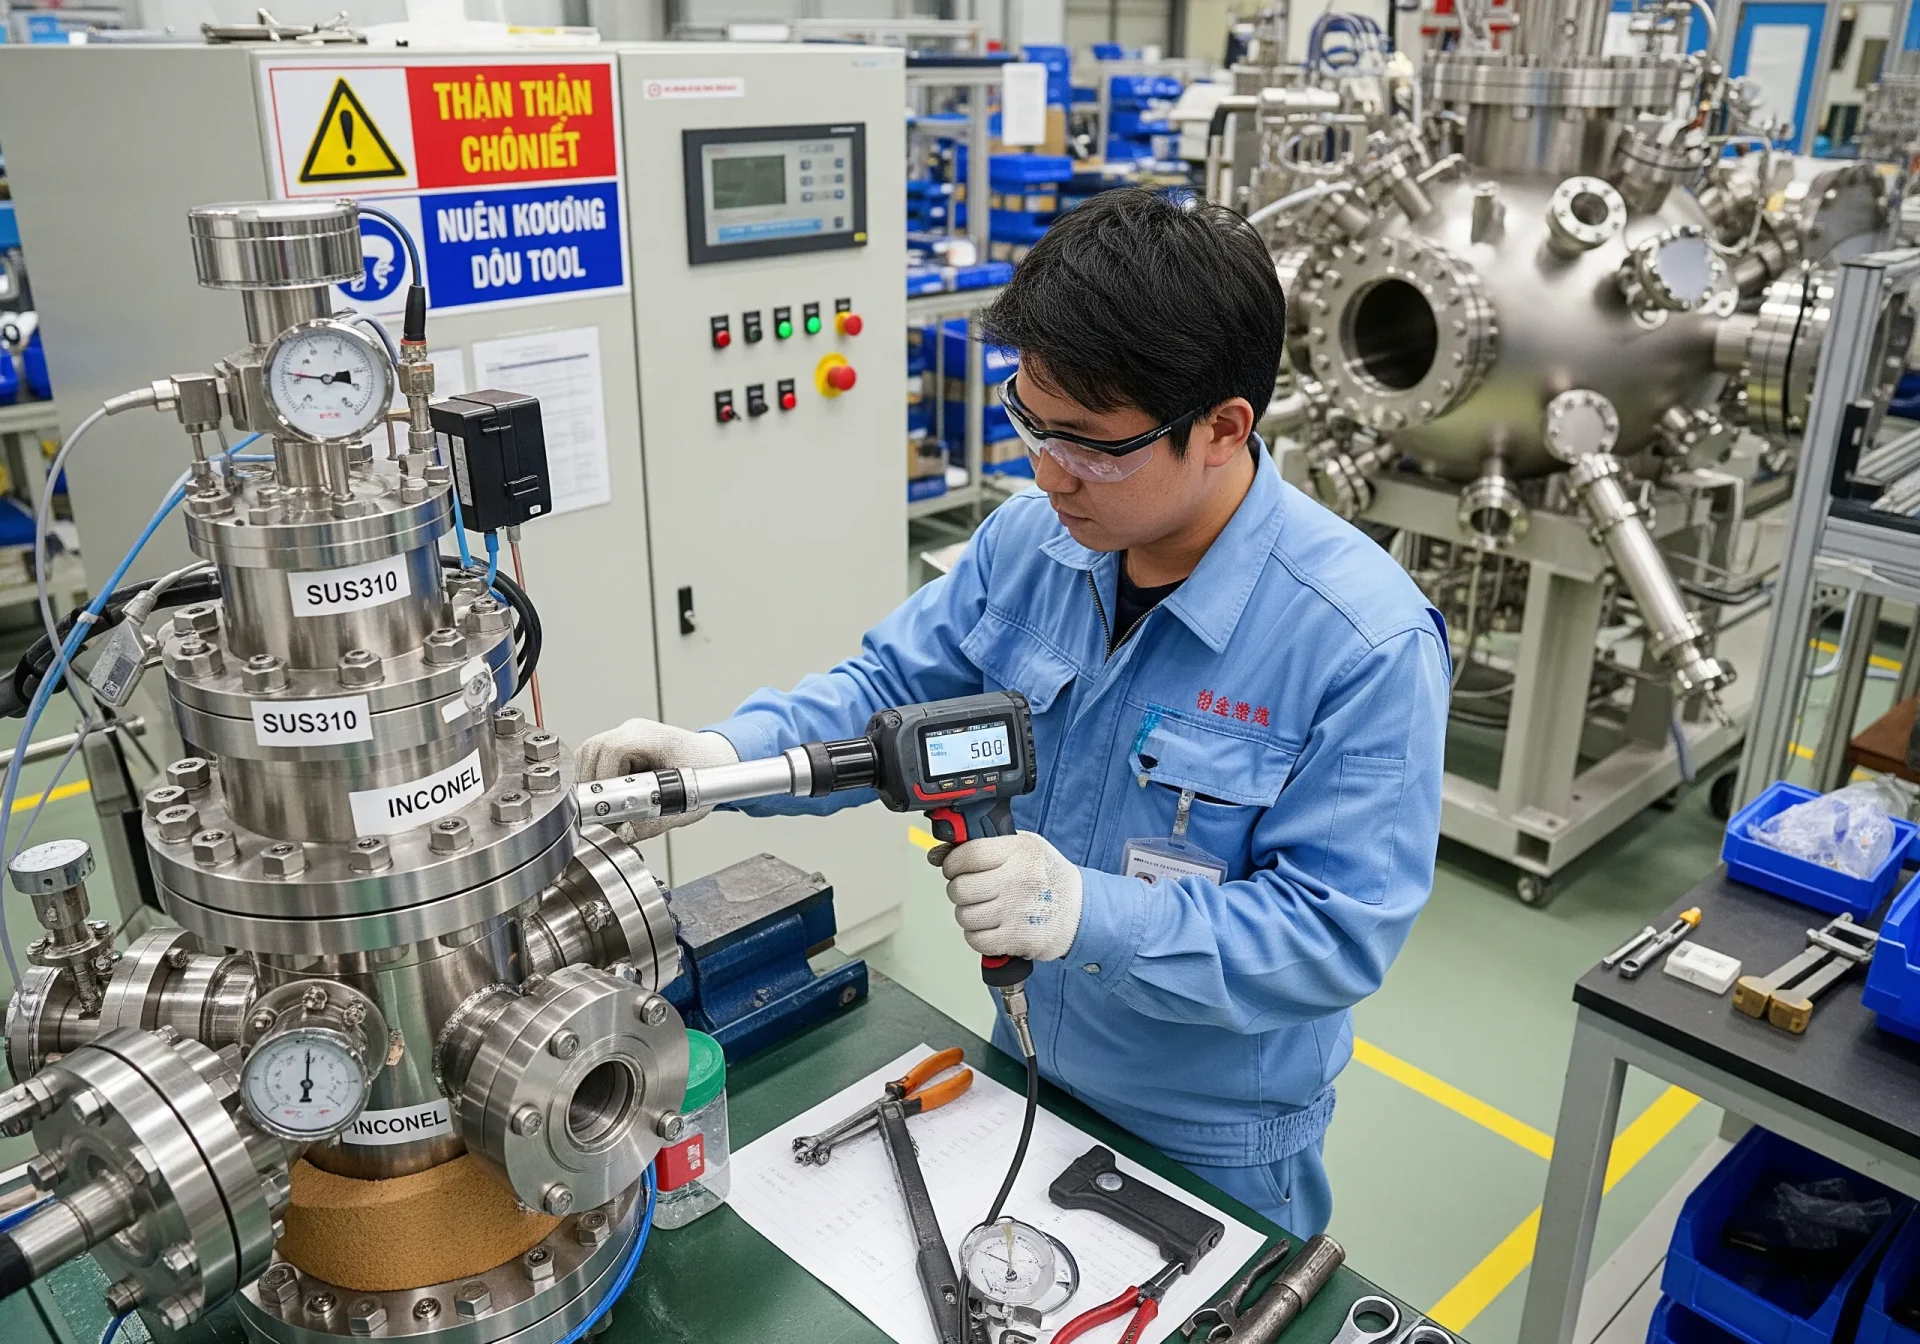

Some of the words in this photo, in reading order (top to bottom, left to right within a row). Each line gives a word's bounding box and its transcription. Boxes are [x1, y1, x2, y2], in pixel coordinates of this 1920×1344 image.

[437, 200, 508, 244] NUÊN
[471, 247, 523, 289] DÔU
[527, 246, 587, 283] TOOL
[307, 571, 397, 605] SUS310
[263, 710, 357, 733] SUS310
[970, 739, 1003, 759] 500
[388, 766, 481, 818] INCONEL
[353, 1110, 447, 1135] INCONEL
